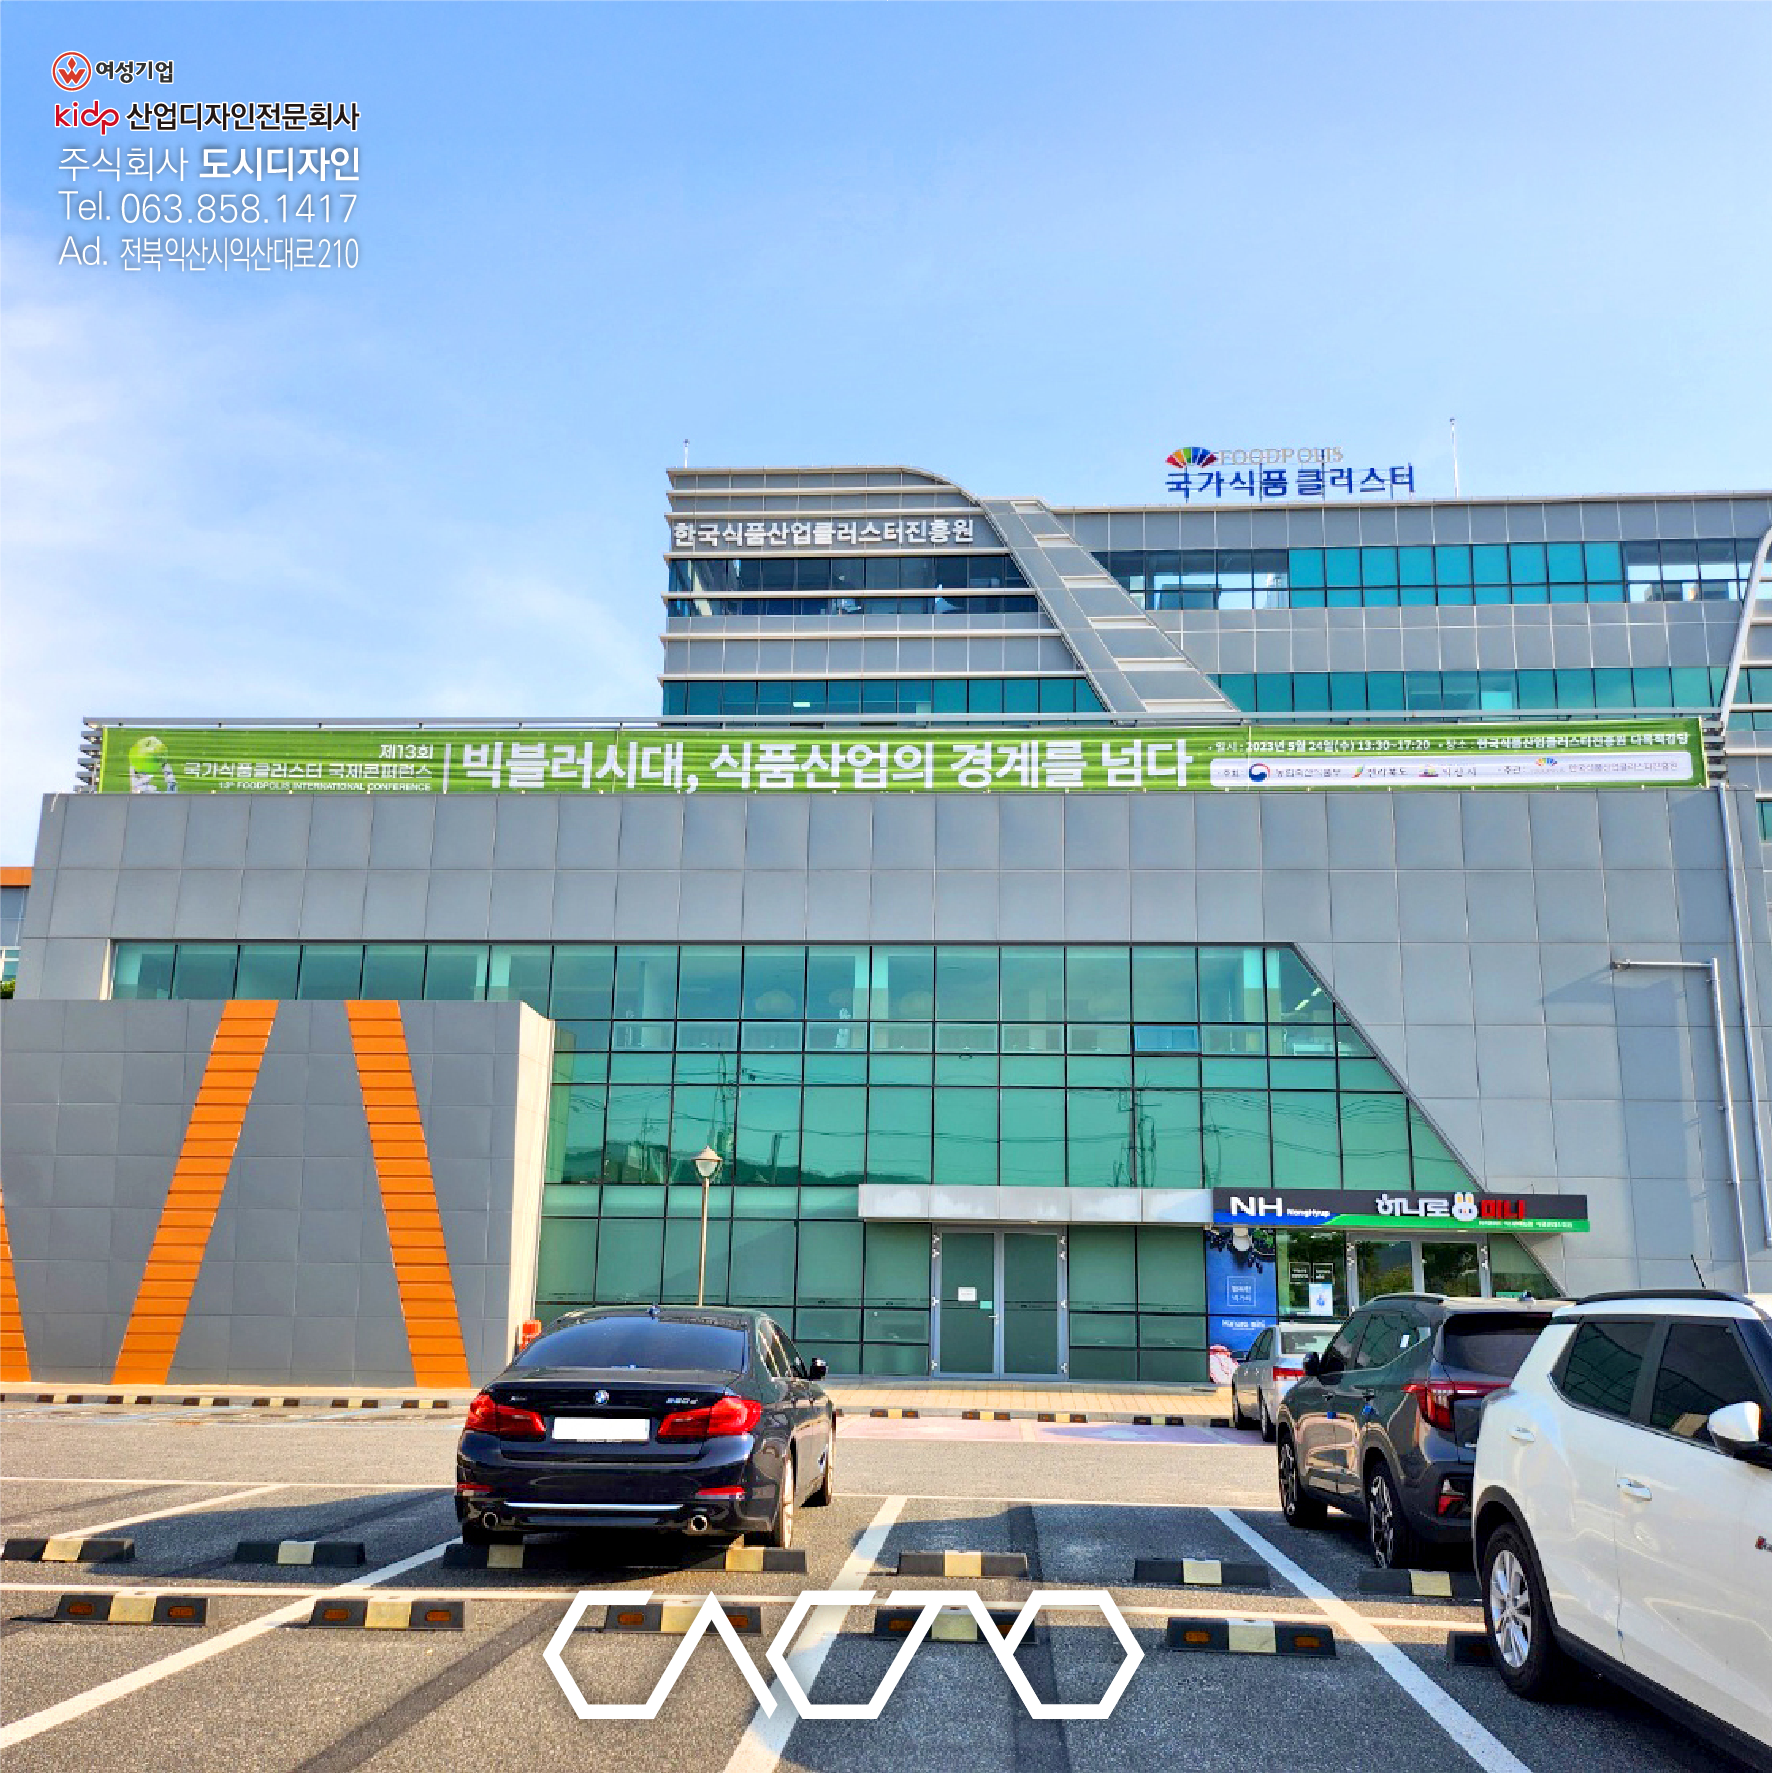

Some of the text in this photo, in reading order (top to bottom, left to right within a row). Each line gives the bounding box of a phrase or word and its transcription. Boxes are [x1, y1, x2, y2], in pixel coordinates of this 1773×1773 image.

[1219, 446, 1345, 466] FOODPOLIS
[1165, 463, 1416, 498] 국가식품클러스터
[673, 518, 974, 547] 한국식품산업클러스터진흥원
[379, 744, 434, 760] 제13회
[183, 762, 322, 779] 국가식품클러스터
[462, 739, 1195, 794] 빅블러시대, 식품산업의 경계를 넘다
[1230, 1196, 1283, 1217] NH
[1375, 1193, 1526, 1220] 하나로 미니
